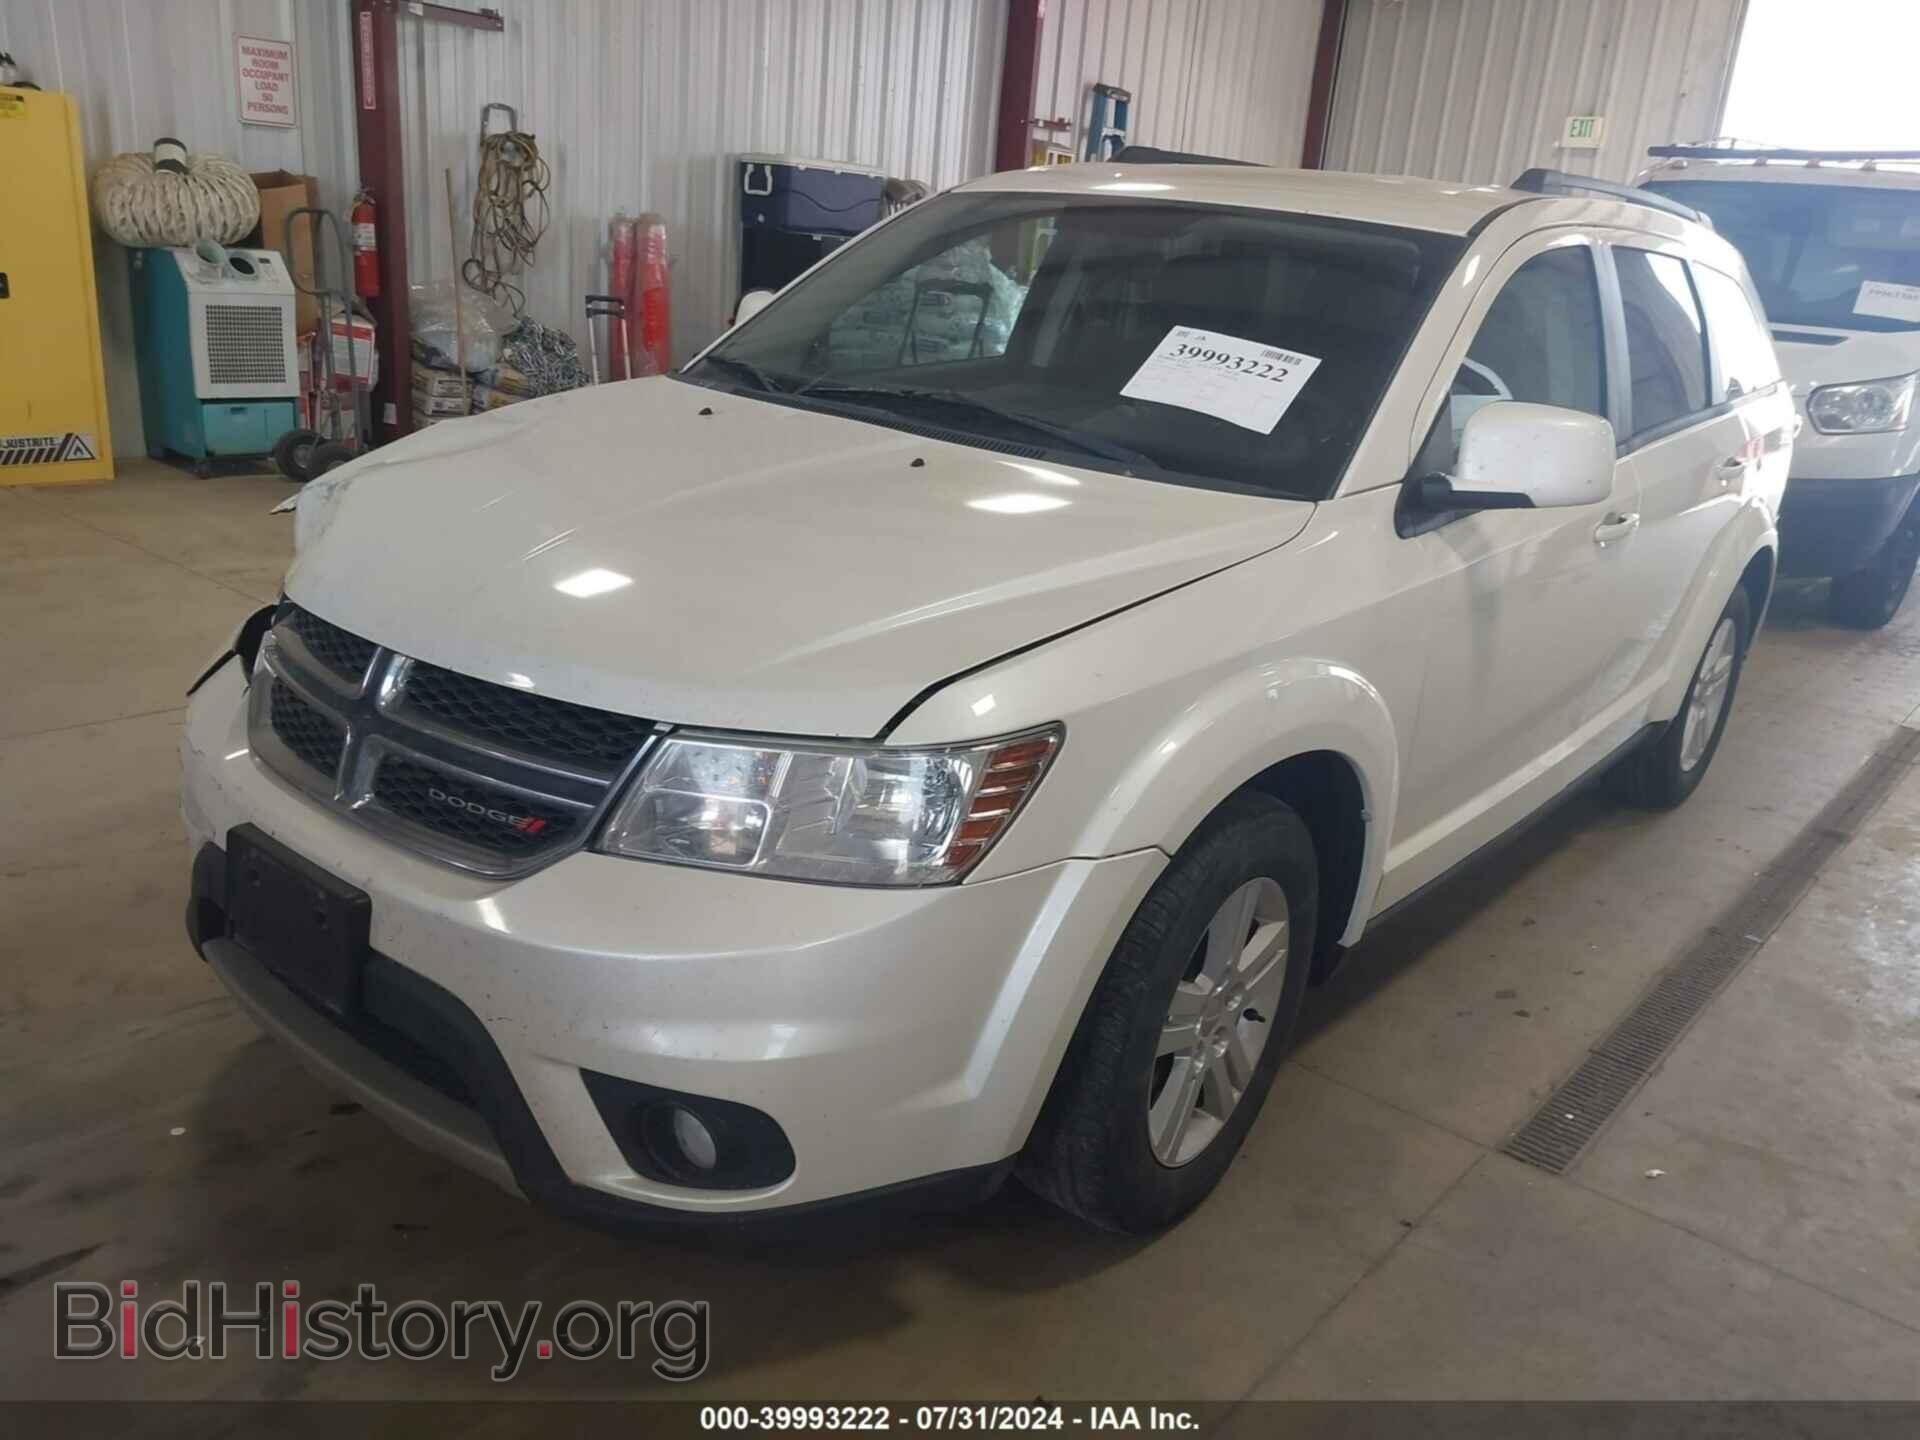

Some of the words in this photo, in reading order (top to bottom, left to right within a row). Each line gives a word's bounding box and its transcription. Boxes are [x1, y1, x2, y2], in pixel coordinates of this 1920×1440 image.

[241, 46, 288, 60] MAXIMUM
[251, 59, 279, 69] ROOM
[242, 67, 289, 82] OCCUPANT
[255, 81, 279, 92] LOAD
[247, 102, 289, 115] PERSONS
[1570, 119, 1594, 138] EXIT
[1169, 343, 1289, 383] 39993222
[428, 787, 528, 827] DODGE
